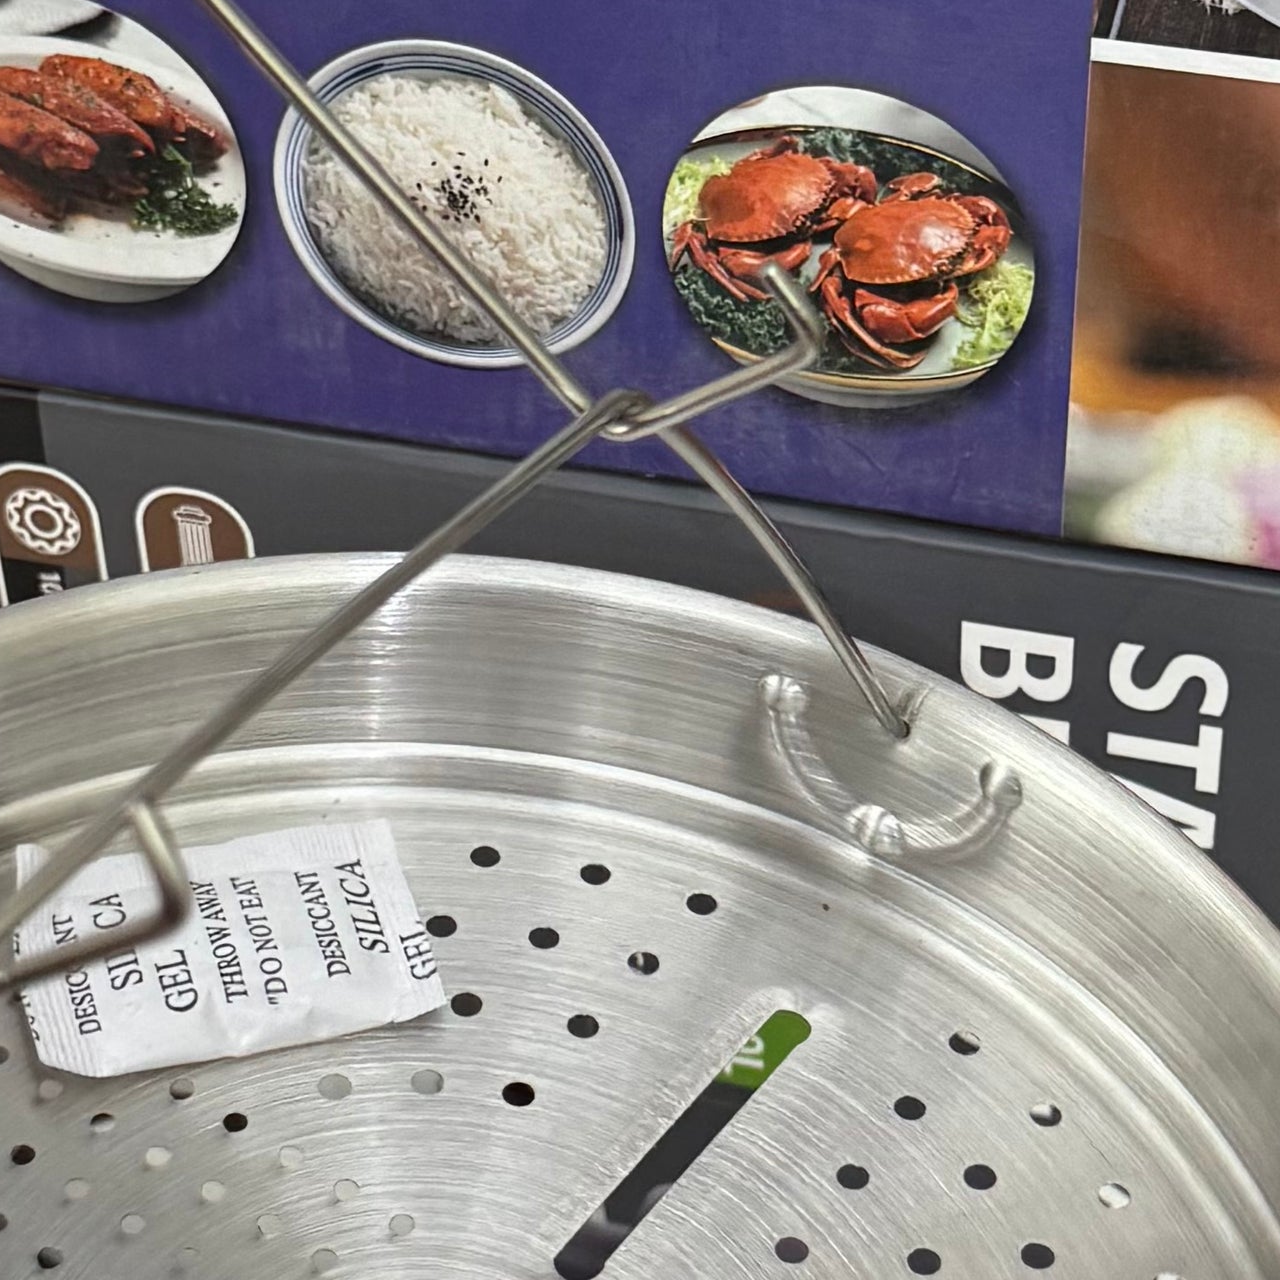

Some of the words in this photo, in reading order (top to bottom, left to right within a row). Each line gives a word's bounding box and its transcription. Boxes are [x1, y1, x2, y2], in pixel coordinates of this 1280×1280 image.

[960, 620, 1075, 748] B
[88, 892, 144, 991] SICA
[189, 880, 227, 923] AWAY
[244, 913, 279, 954] NOT
[294, 870, 353, 979] DESICCANT
[333, 857, 391, 955] SILICA
[52, 913, 103, 1036] DESICNT
[154, 949, 199, 1013] GEL
[206, 926, 249, 1004] THROW
